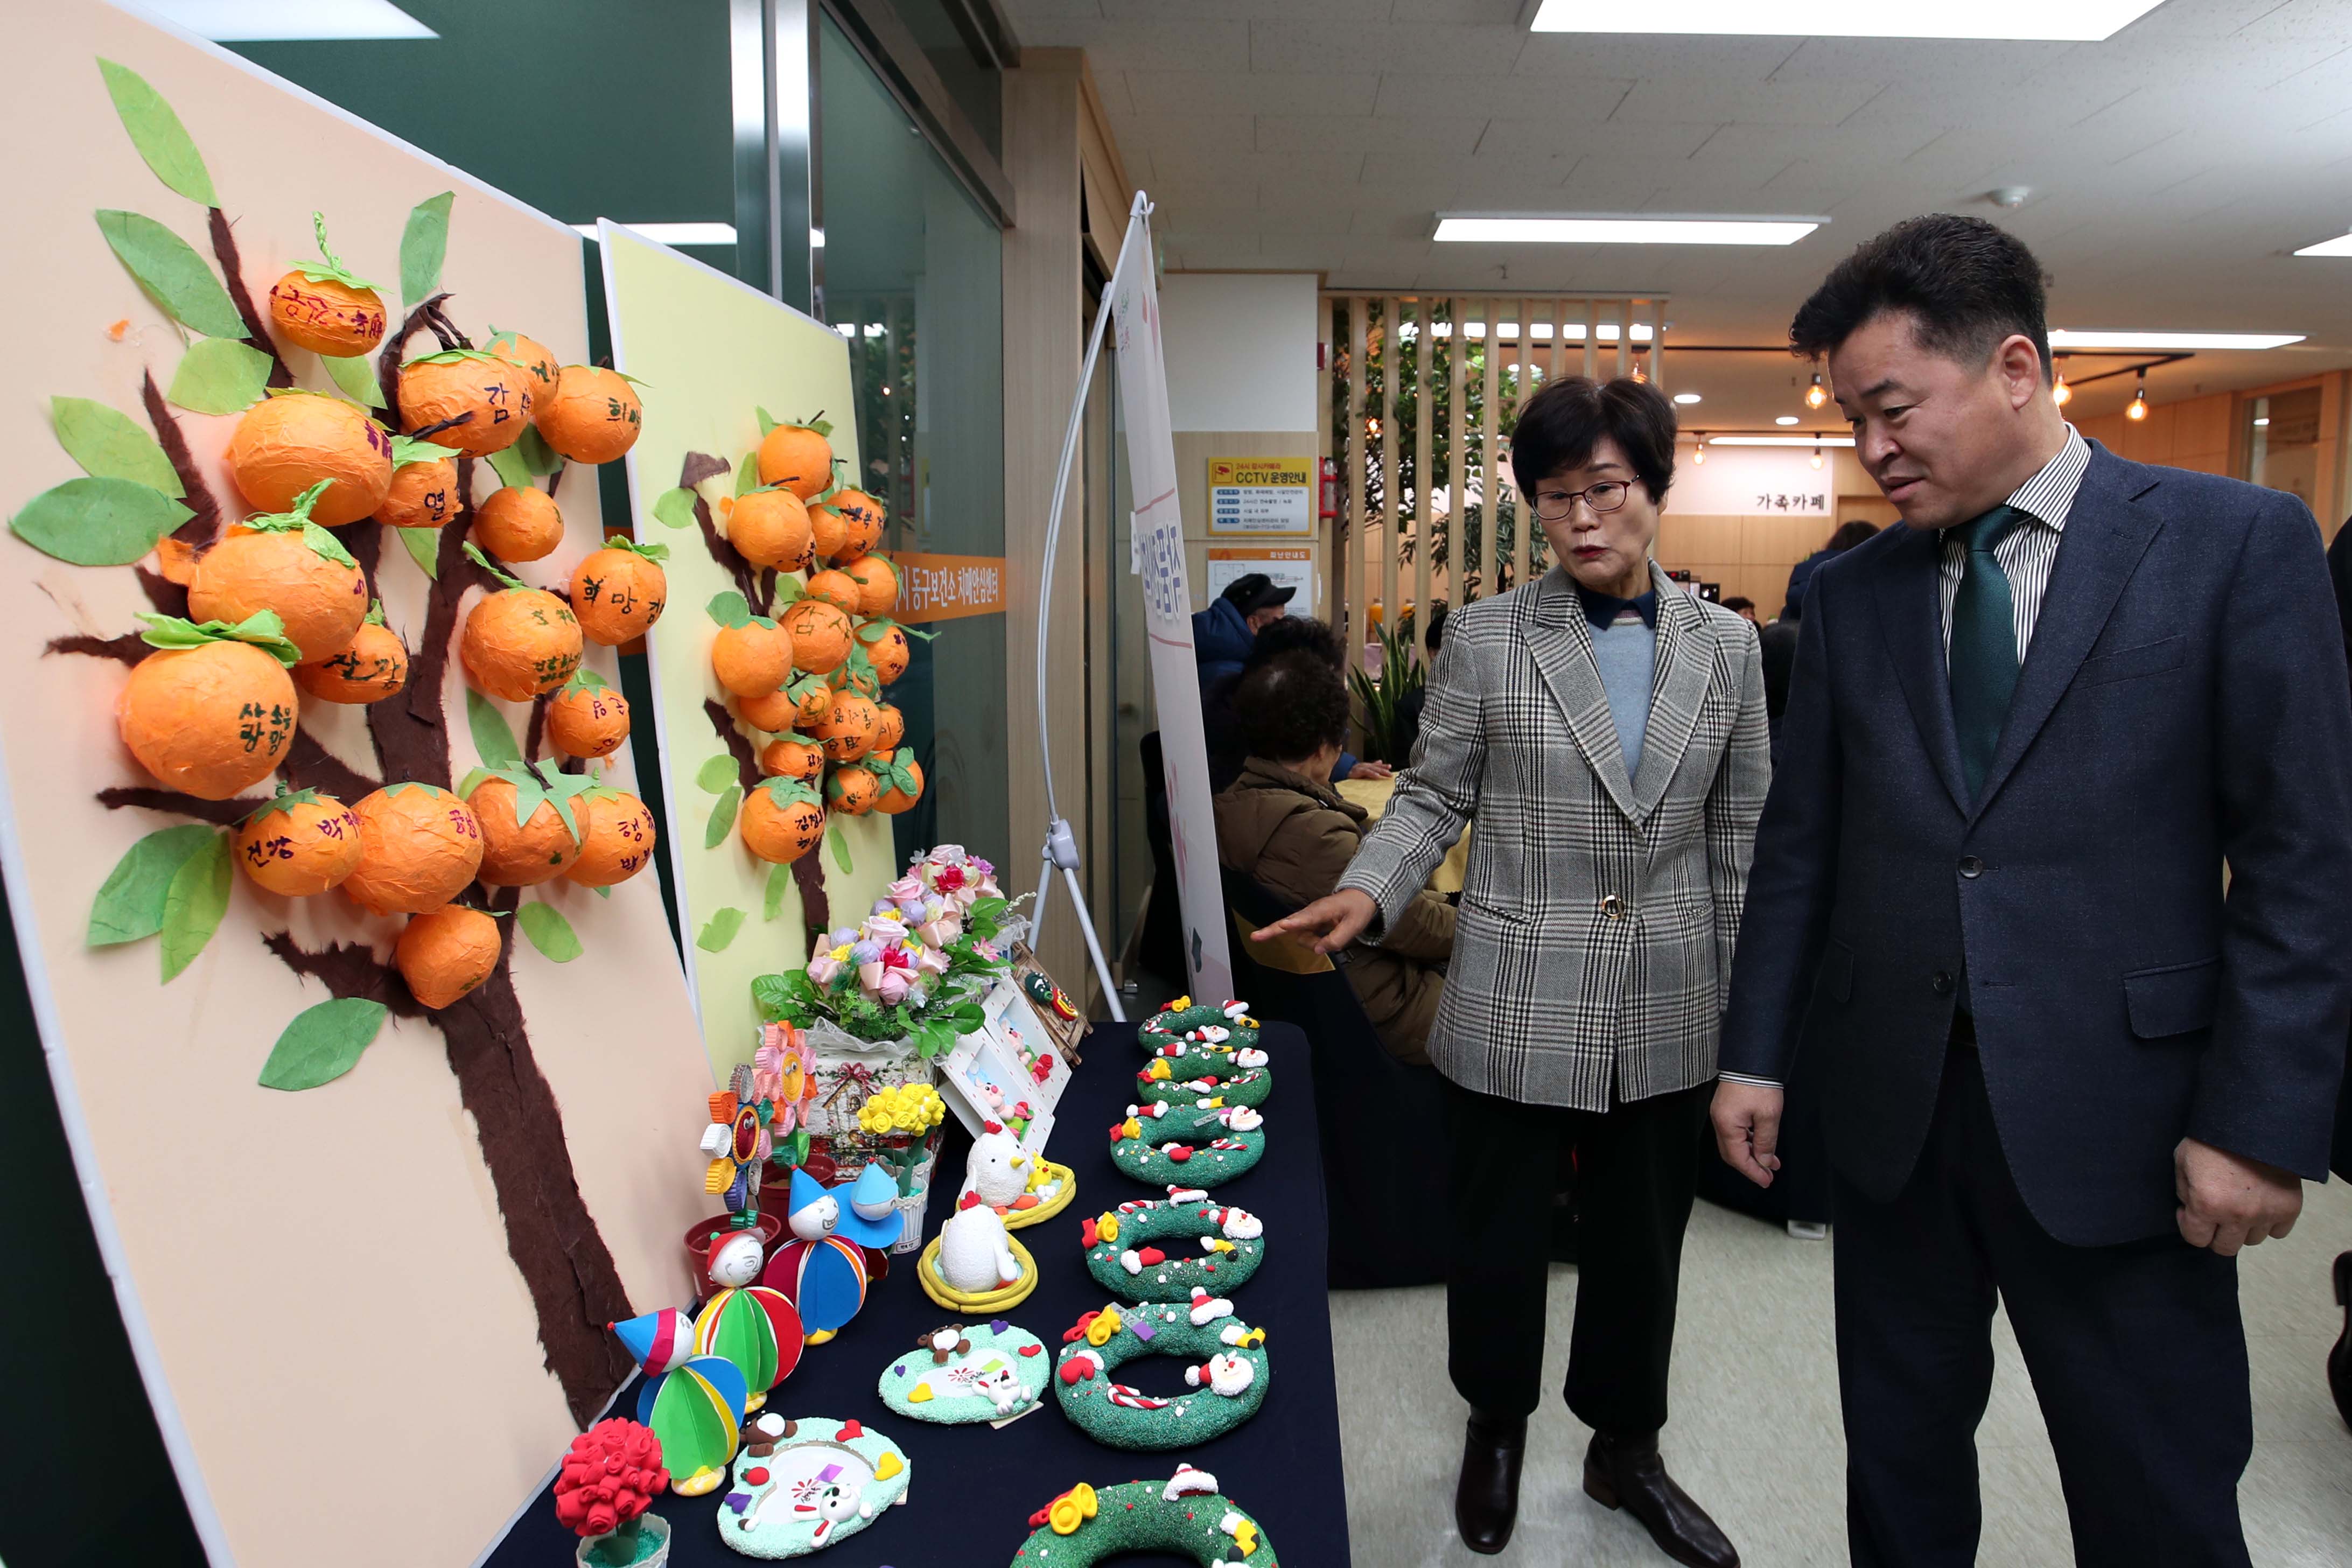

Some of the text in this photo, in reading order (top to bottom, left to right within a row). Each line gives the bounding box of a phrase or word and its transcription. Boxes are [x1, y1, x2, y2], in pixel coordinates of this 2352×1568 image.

[1236, 472, 1307, 484] CCTV 운영안내
[1756, 493, 1825, 512] 가족카페
[1270, 551, 1306, 559] 피난안내도
[912, 566, 956, 610] 동구보건소
[958, 567, 998, 606] 치매안심센터
